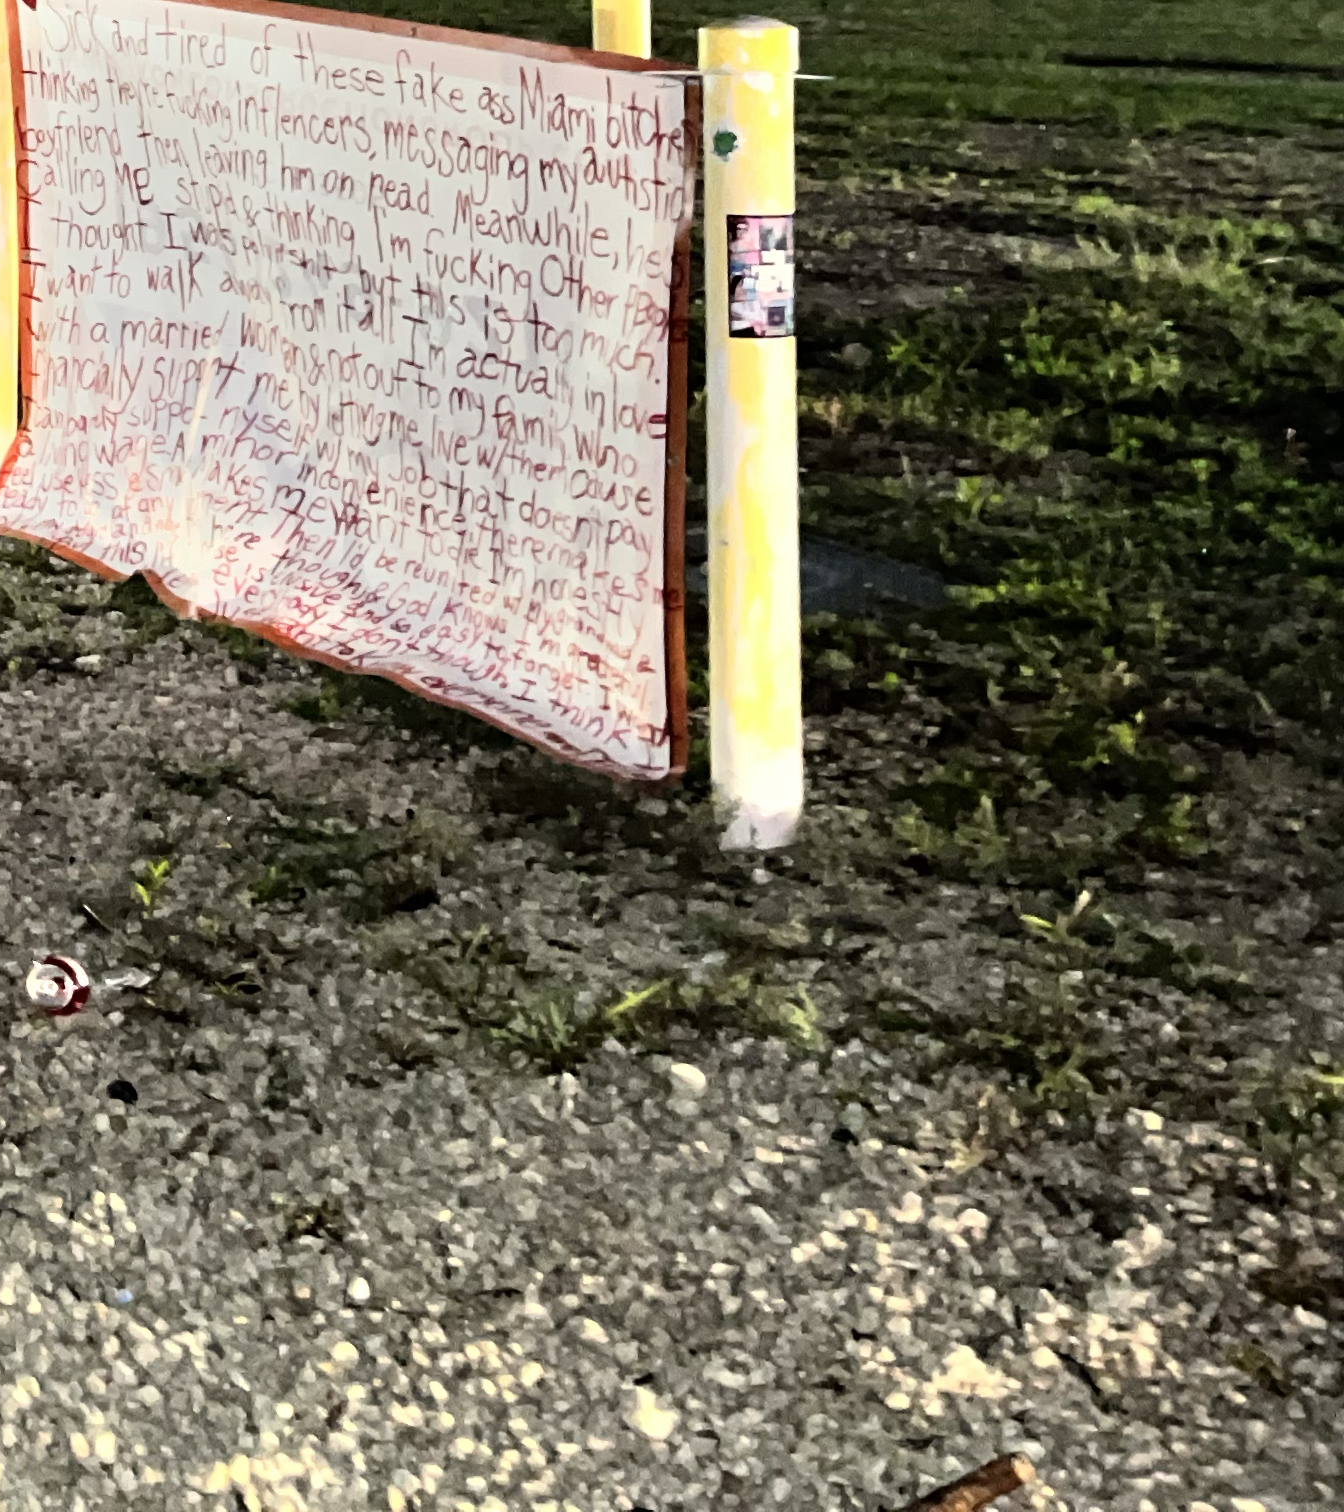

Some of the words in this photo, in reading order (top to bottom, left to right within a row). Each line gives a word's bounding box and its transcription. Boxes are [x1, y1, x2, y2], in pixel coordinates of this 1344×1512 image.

[111, 18, 149, 56] and
[155, 7, 226, 68] tired
[250, 23, 277, 77] of
[294, 30, 385, 97] these
[395, 48, 467, 113] fake
[478, 86, 515, 125] ass
[519, 66, 596, 144] Miami
[21, 49, 100, 114] thinking
[383, 116, 529, 216] messaging
[539, 156, 579, 213] my
[192, 127, 268, 189] leaving
[323, 168, 355, 199] on
[51, 205, 148, 266] thought
[159, 211, 188, 251] I
[484, 295, 515, 344] is
[423, 227, 533, 322] fucking
[47, 255, 103, 298] want
[105, 253, 131, 298] to
[584, 372, 605, 427] in
[612, 370, 669, 439] love
[90, 321, 110, 343] a
[414, 371, 442, 410] to
[447, 386, 486, 439] my
[247, 371, 295, 411] me
[269, 484, 328, 522] me
[439, 470, 515, 522] that
